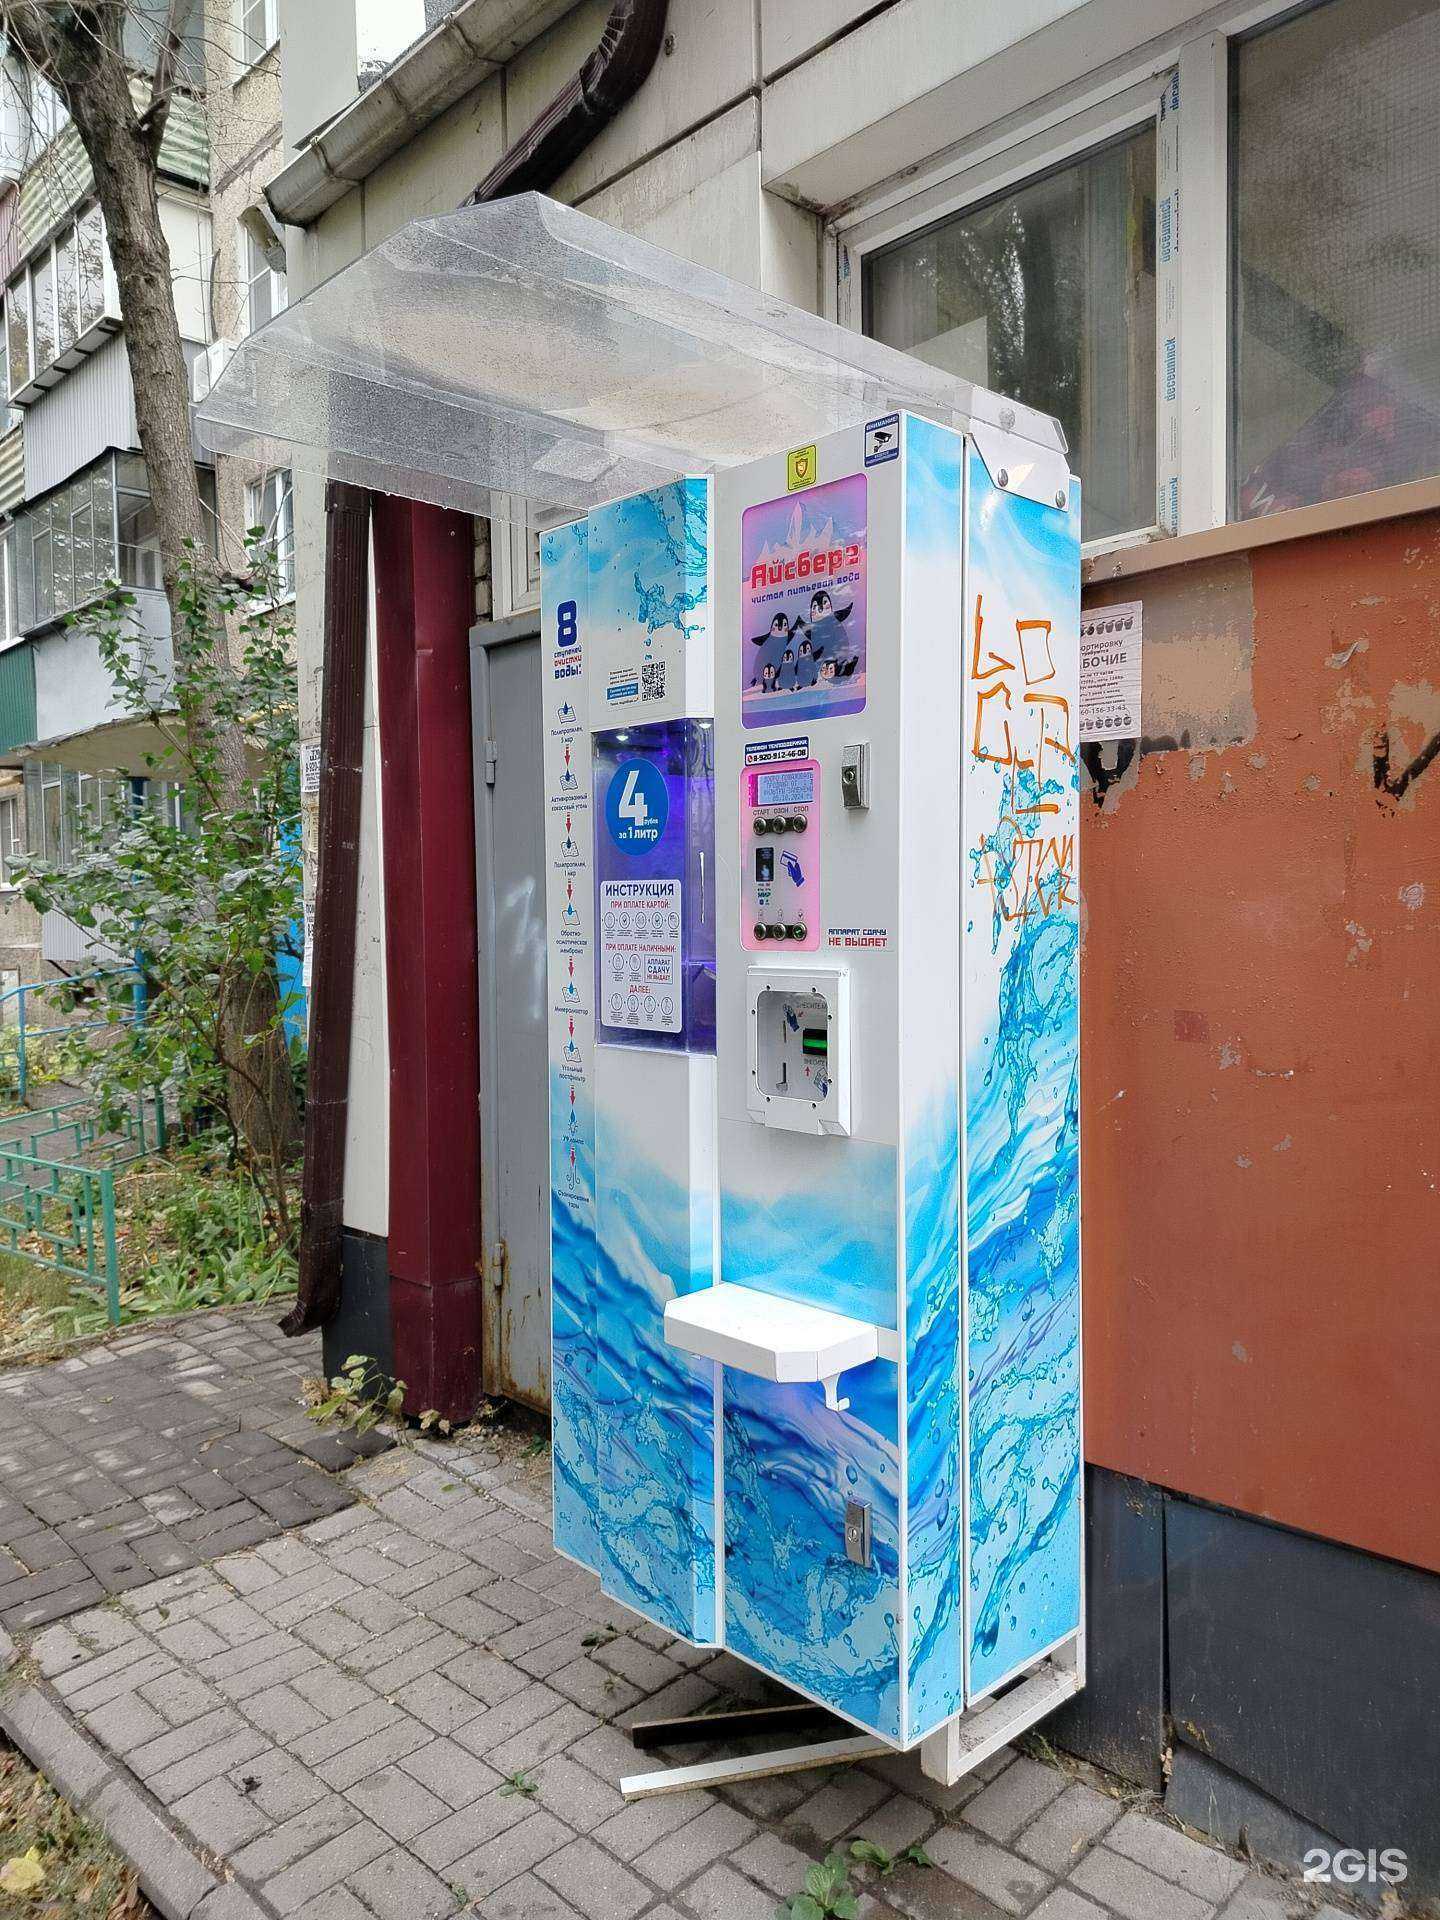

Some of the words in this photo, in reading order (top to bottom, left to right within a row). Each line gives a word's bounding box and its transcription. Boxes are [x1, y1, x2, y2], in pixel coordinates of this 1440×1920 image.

[1160, 197, 1171, 263] deceuninck
[1164, 336, 1176, 401] deceuninck
[751, 591, 783, 604] чистая
[787, 580, 834, 596] питьевая
[558, 600, 577, 647] 8
[555, 655, 582, 667] очистки
[1081, 652, 1127, 669] БОЧИЕ
[555, 664, 582, 680] воды:
[1080, 704, 1126, 716] 60-156-33-43
[619, 770, 648, 826] 4
[628, 827, 633, 839] 1
[634, 829, 658, 841] литр
[605, 883, 674, 897] ИНСТРУКЦИЯ
[610, 900, 622, 909] ПРИ
[623, 900, 646, 909] ОПЛАТЕ
[646, 899, 671, 909] КАРТОЙ:
[828, 928, 860, 936] АППАРАТ
[862, 928, 887, 936] СДАЧУ
[605, 943, 616, 951] ПРИ
[617, 943, 638, 951] ОПЛАТЕ
[828, 937, 842, 946] НЕ
[844, 937, 888, 947] ВЫДАЕТ
[647, 965, 671, 974] СДАЧУ
